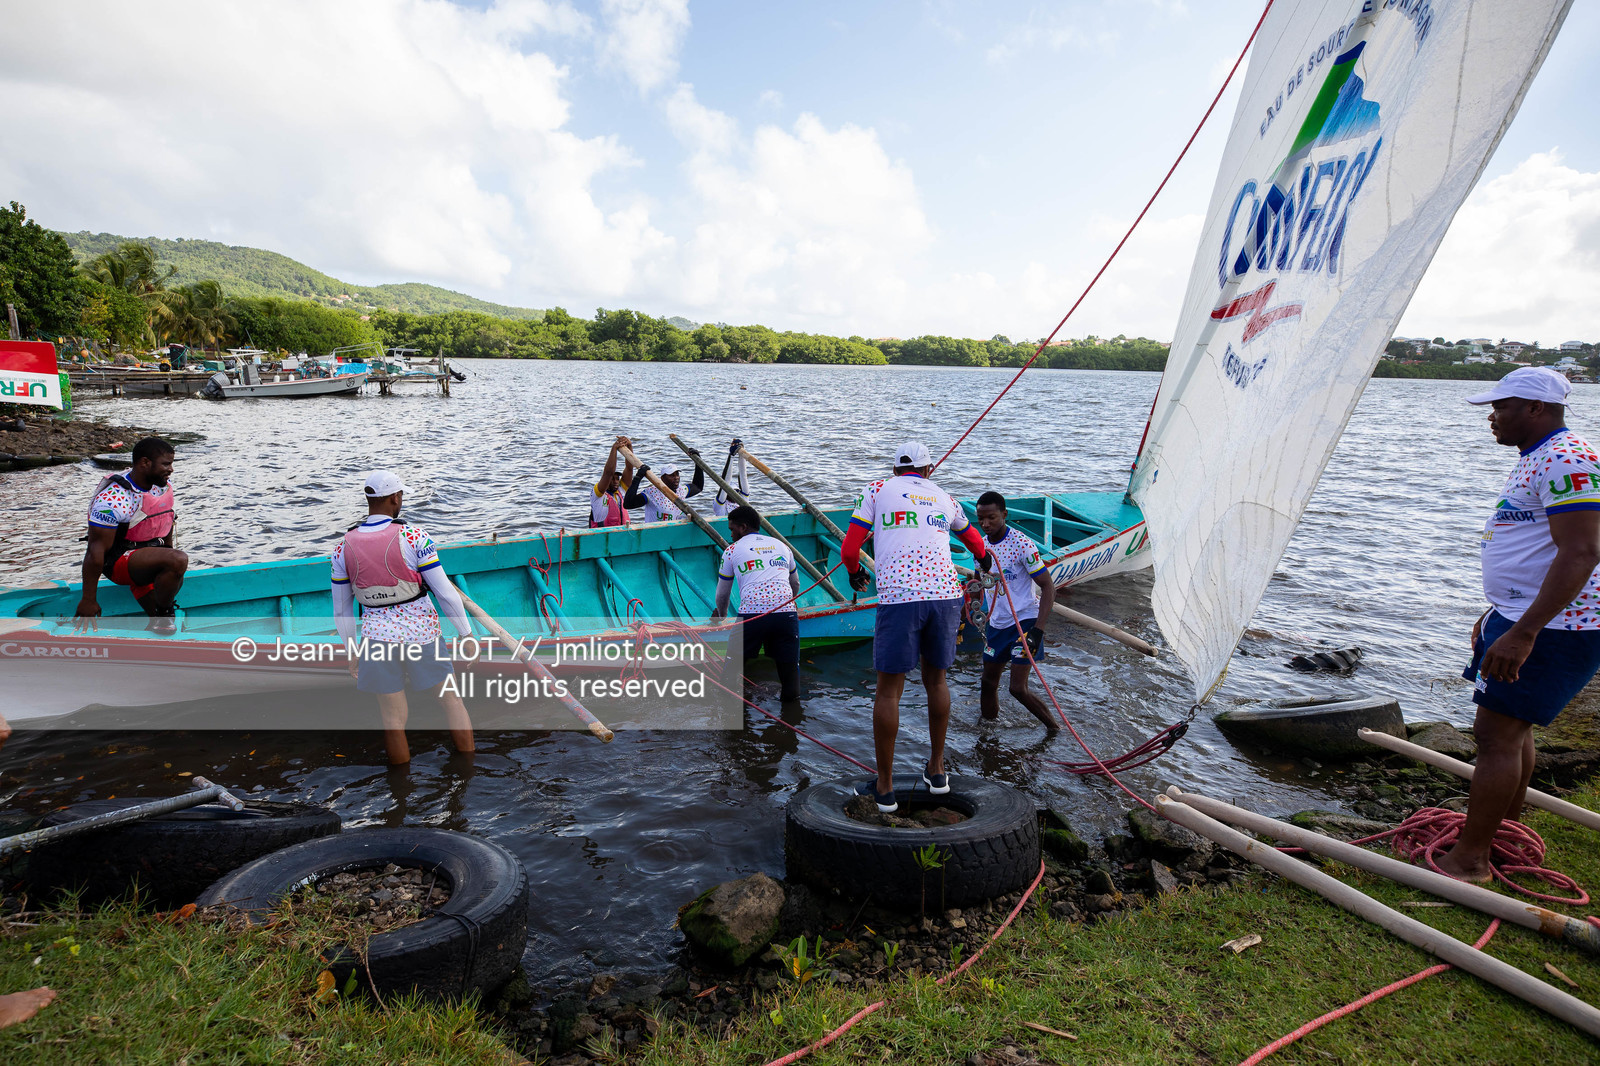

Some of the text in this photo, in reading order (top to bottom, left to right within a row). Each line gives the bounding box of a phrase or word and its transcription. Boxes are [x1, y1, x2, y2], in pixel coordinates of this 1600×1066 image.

[1260, 95, 1283, 138] EAU
[1286, 66, 1304, 97] DE
[0, 381, 47, 398] UFR
[881, 511, 919, 527] UFR
[737, 559, 765, 573] UFR
[1026, 551, 1040, 565] UF
[0, 642, 109, 658] CARACOLI
